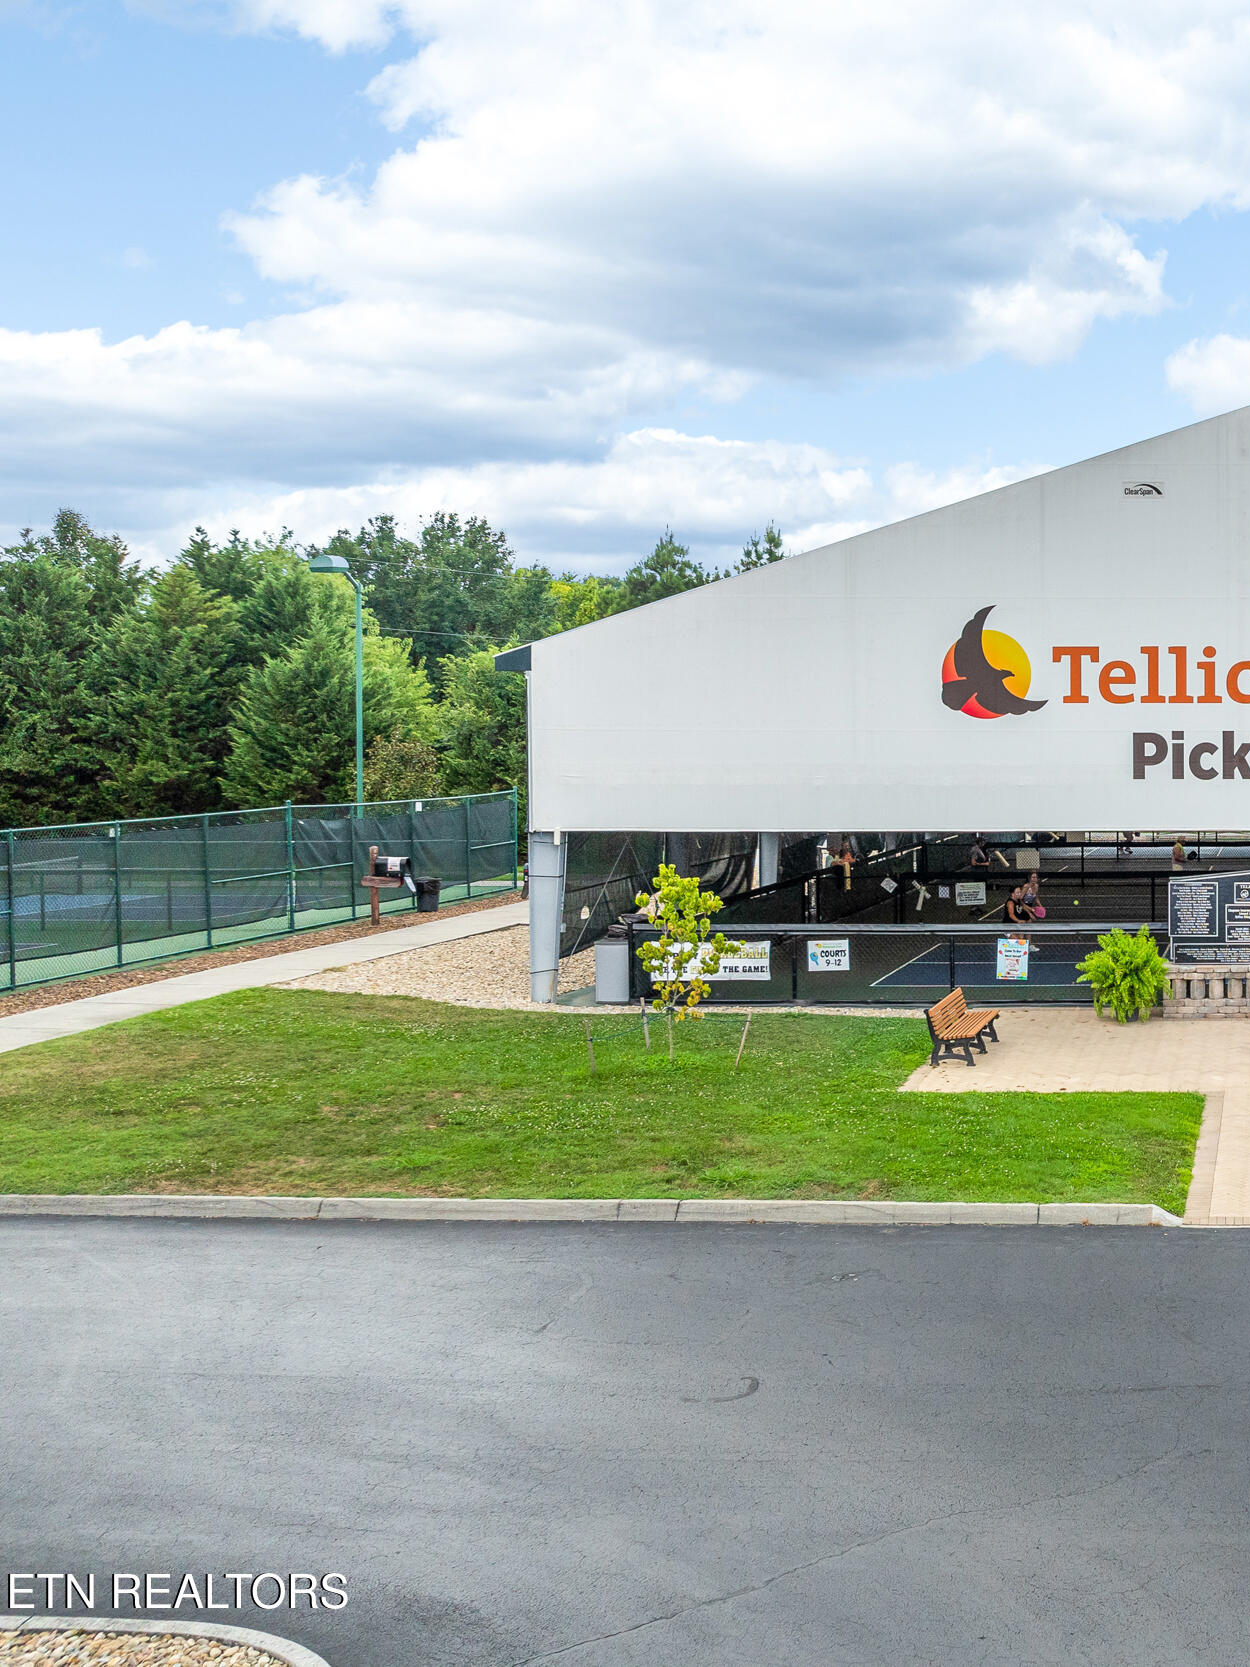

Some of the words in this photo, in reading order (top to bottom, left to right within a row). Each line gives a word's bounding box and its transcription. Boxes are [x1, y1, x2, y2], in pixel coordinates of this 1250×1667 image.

[820, 949, 847, 958] COURTS
[825, 959, 842, 967] 9-12
[722, 965, 740, 973] THE
[742, 965, 768, 973] GAME!
